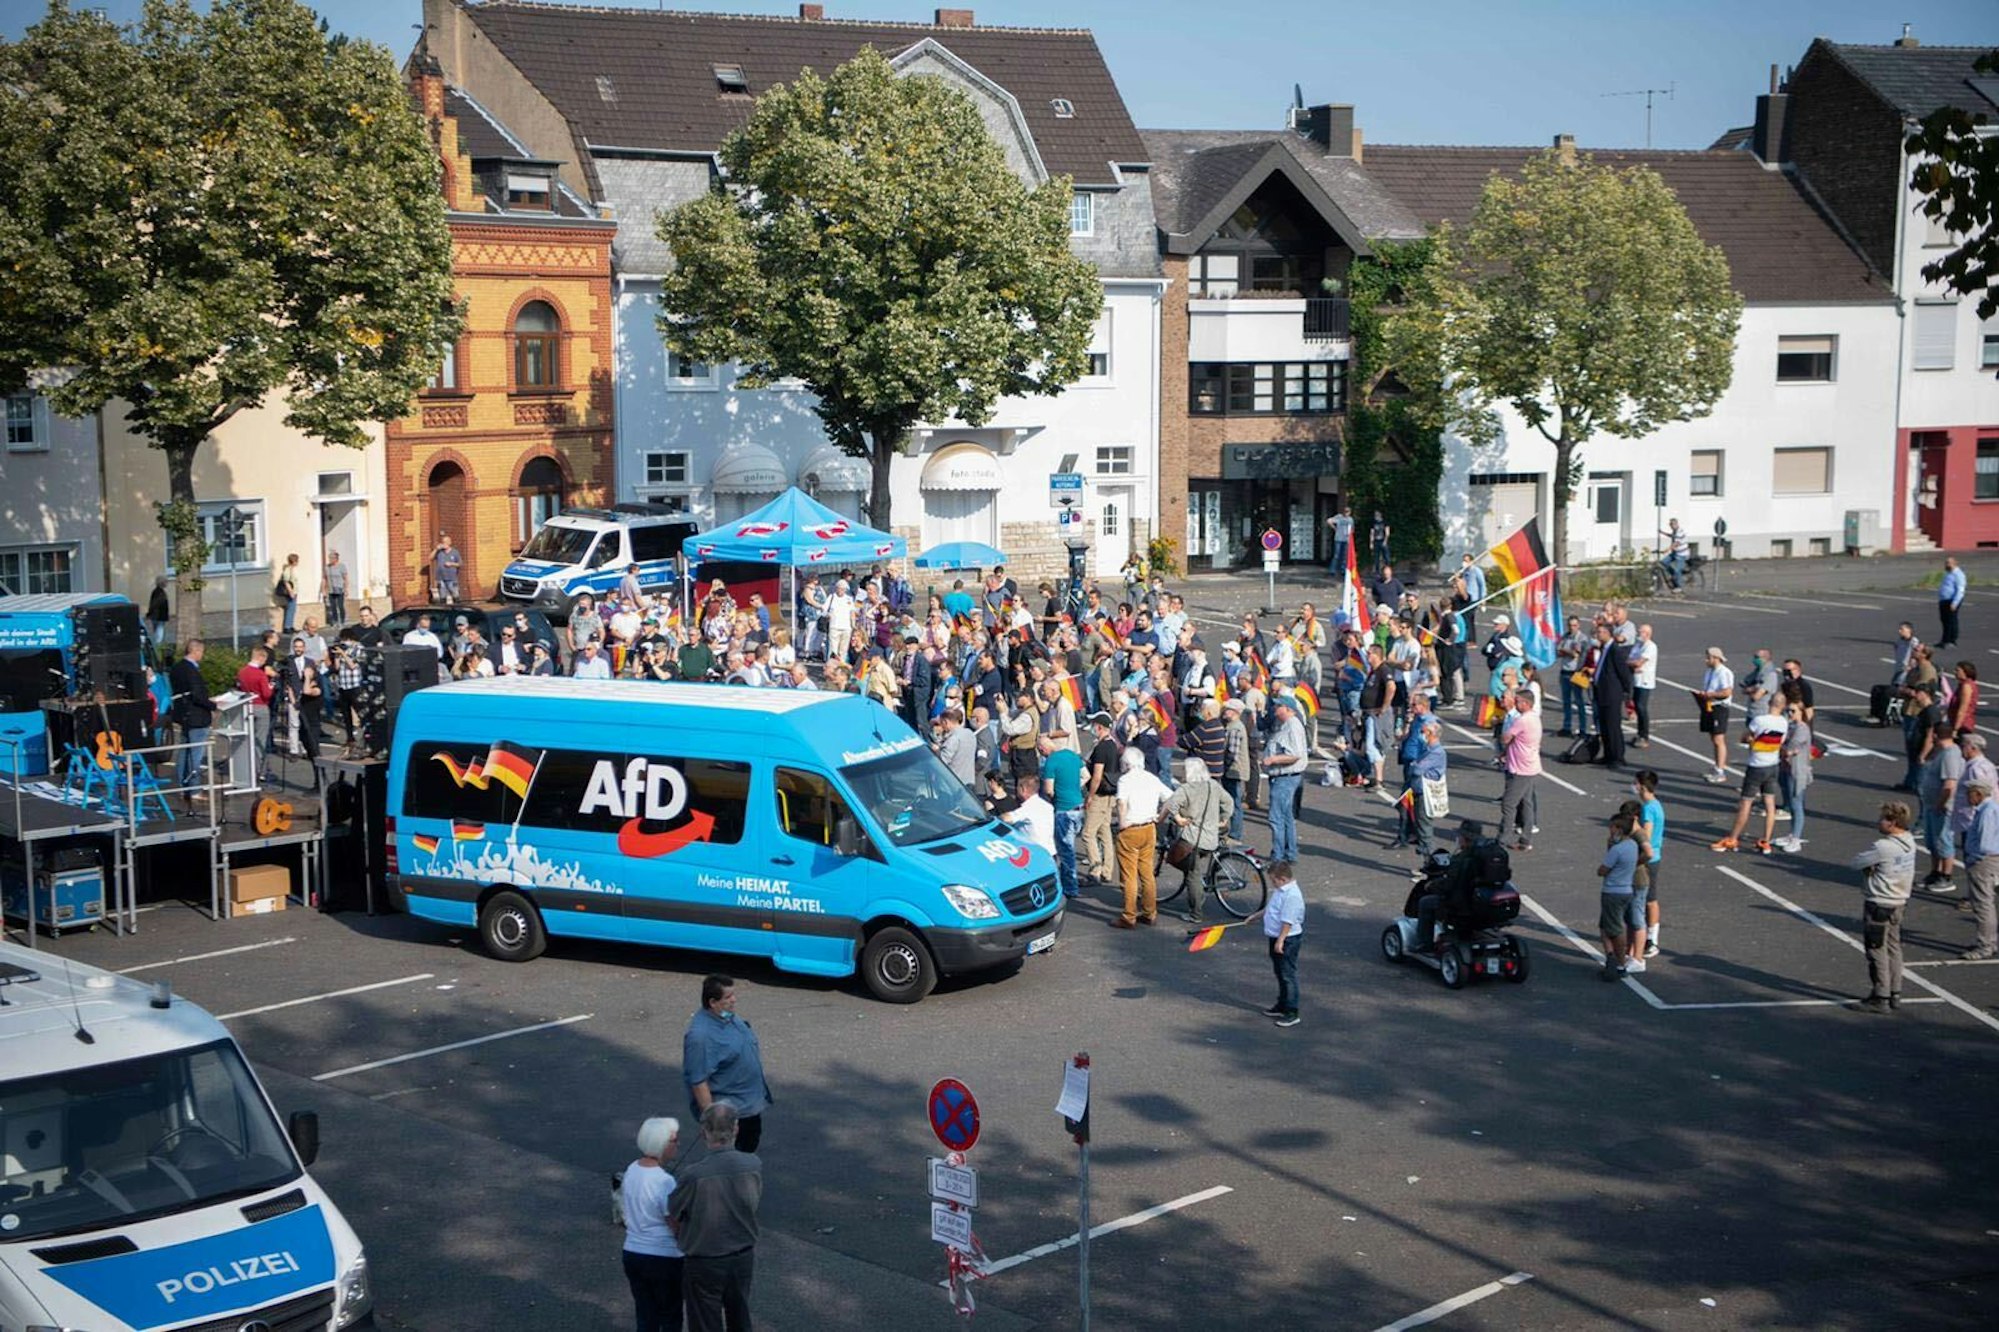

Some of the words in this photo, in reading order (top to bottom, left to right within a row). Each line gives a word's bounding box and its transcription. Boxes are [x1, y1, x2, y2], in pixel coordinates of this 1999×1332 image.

[744, 472, 776, 482] galerie
[511, 566, 543, 574] POLIZEI
[578, 757, 687, 821] AfD
[977, 839, 1018, 862] AfD
[697, 874, 733, 889] Meine
[735, 876, 791, 895] HEIMAT.
[737, 894, 773, 909] Meine
[773, 897, 825, 914] PARTEI.
[156, 1251, 300, 1304] POLIZEI
